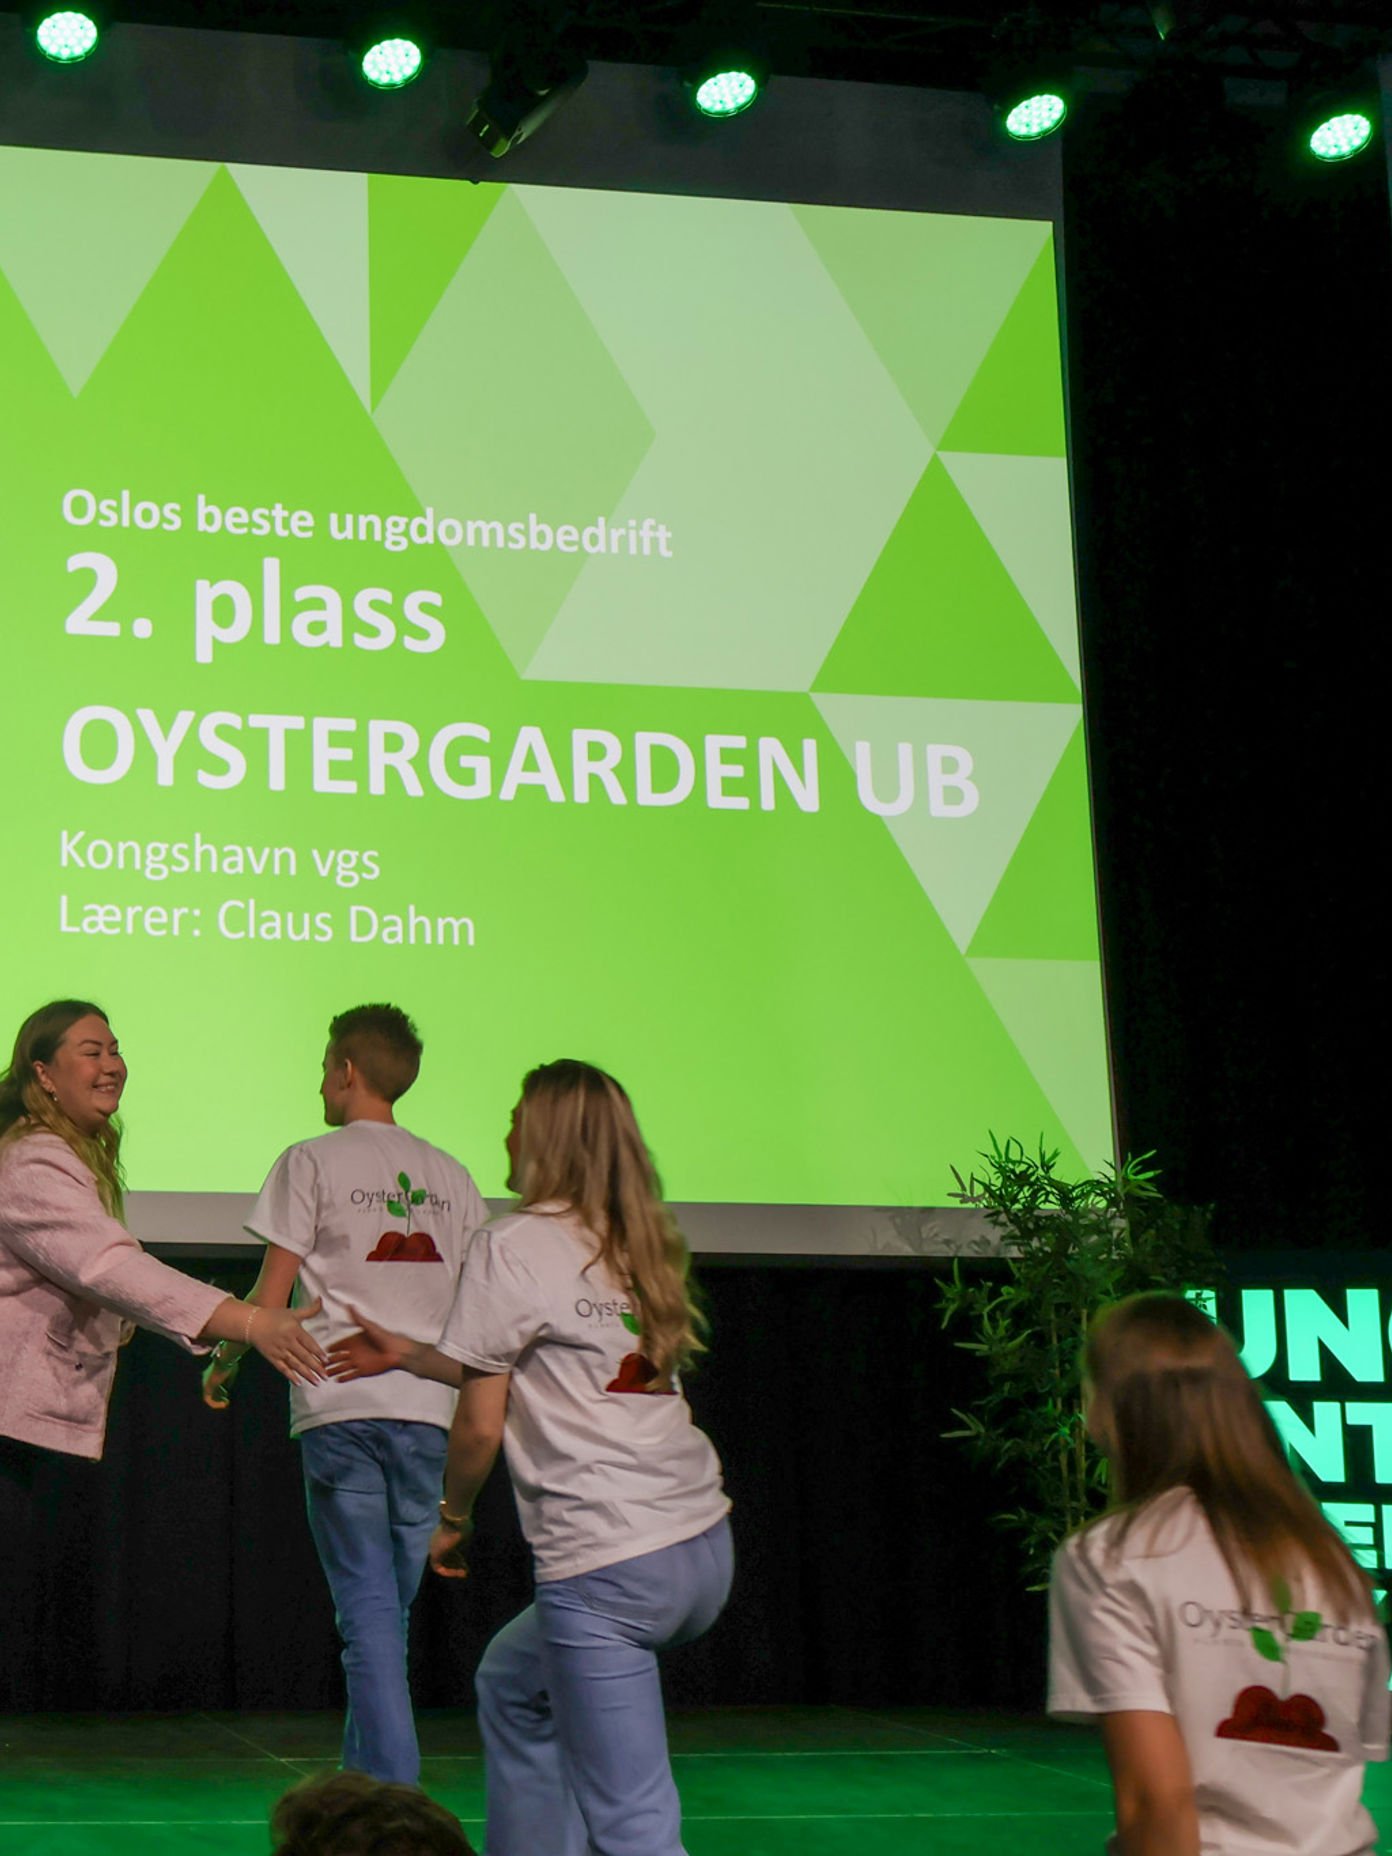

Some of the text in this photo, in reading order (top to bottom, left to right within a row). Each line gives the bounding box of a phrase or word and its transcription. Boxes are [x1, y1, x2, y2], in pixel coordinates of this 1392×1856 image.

[62, 489, 674, 558] Oslos beste ungdomsbedrift
[65, 550, 446, 664] 2. plass
[62, 704, 980, 818] OYSTERGARDEN UB
[60, 830, 381, 888] Kongshavn vgs
[59, 896, 476, 947] Lærer: Claus Dahm
[574, 1298, 631, 1323] Oyste
